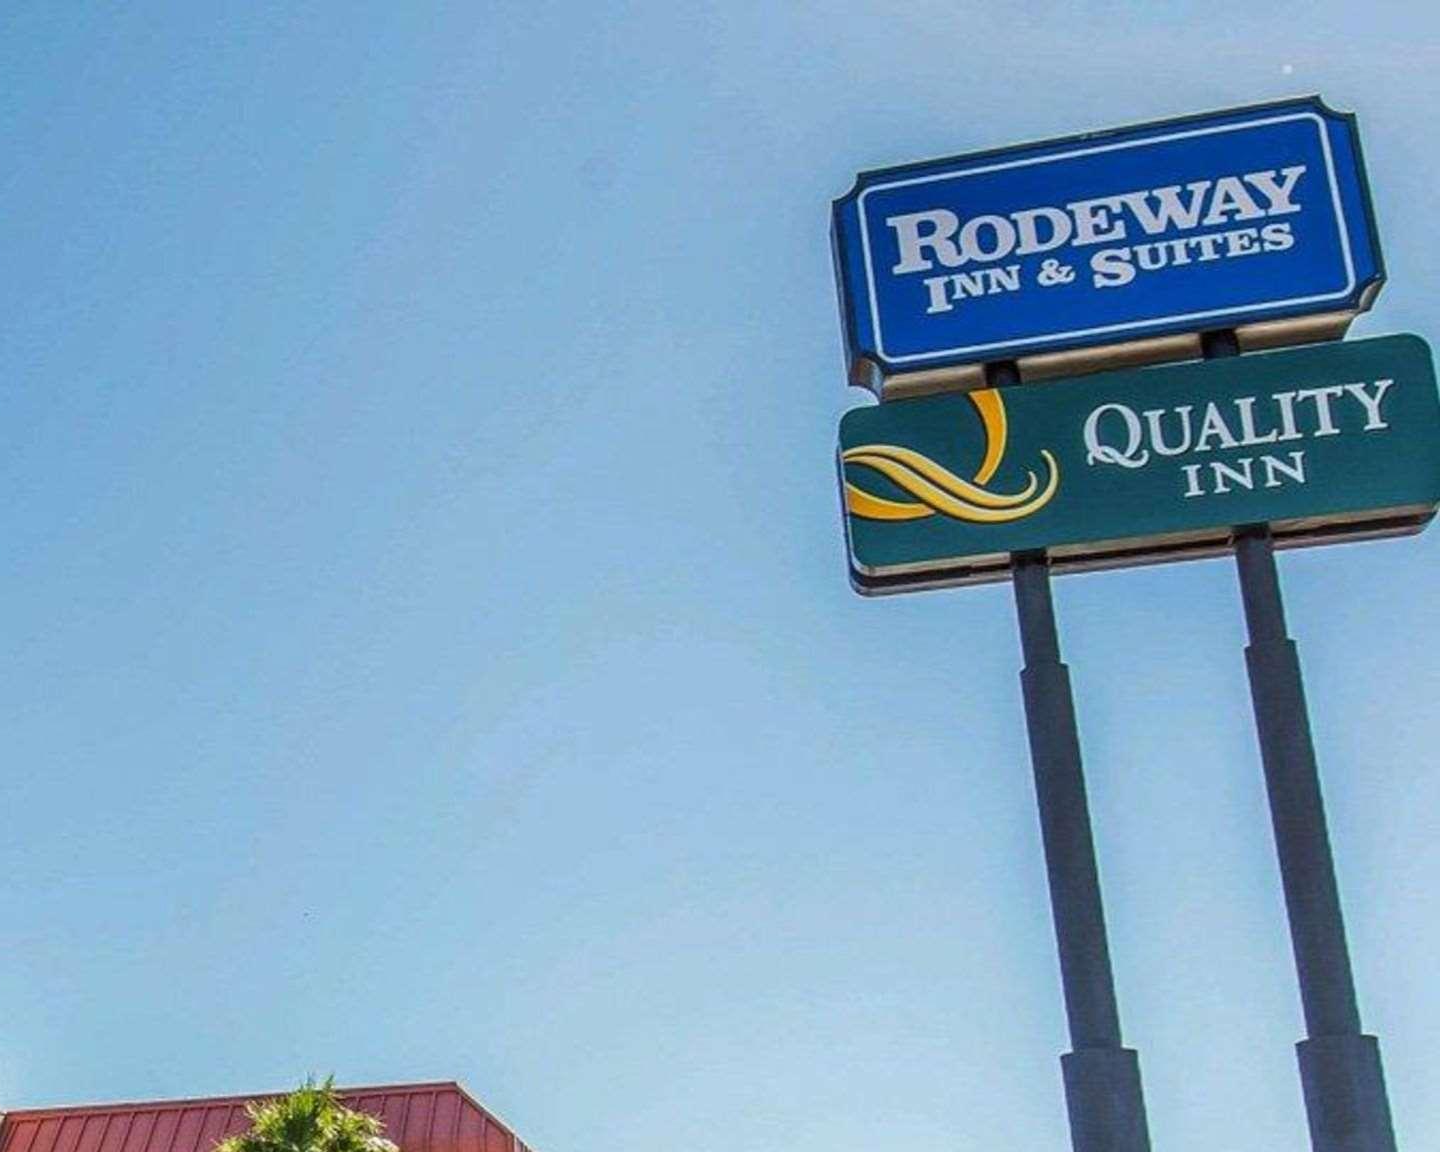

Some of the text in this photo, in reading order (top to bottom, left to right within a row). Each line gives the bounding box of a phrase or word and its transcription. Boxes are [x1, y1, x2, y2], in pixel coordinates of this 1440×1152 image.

[886, 165, 1307, 275] RODEWAY
[923, 222, 1295, 314] INN & SUITES
[1083, 379, 1394, 468] QUALITY
[1181, 451, 1306, 497] INN
